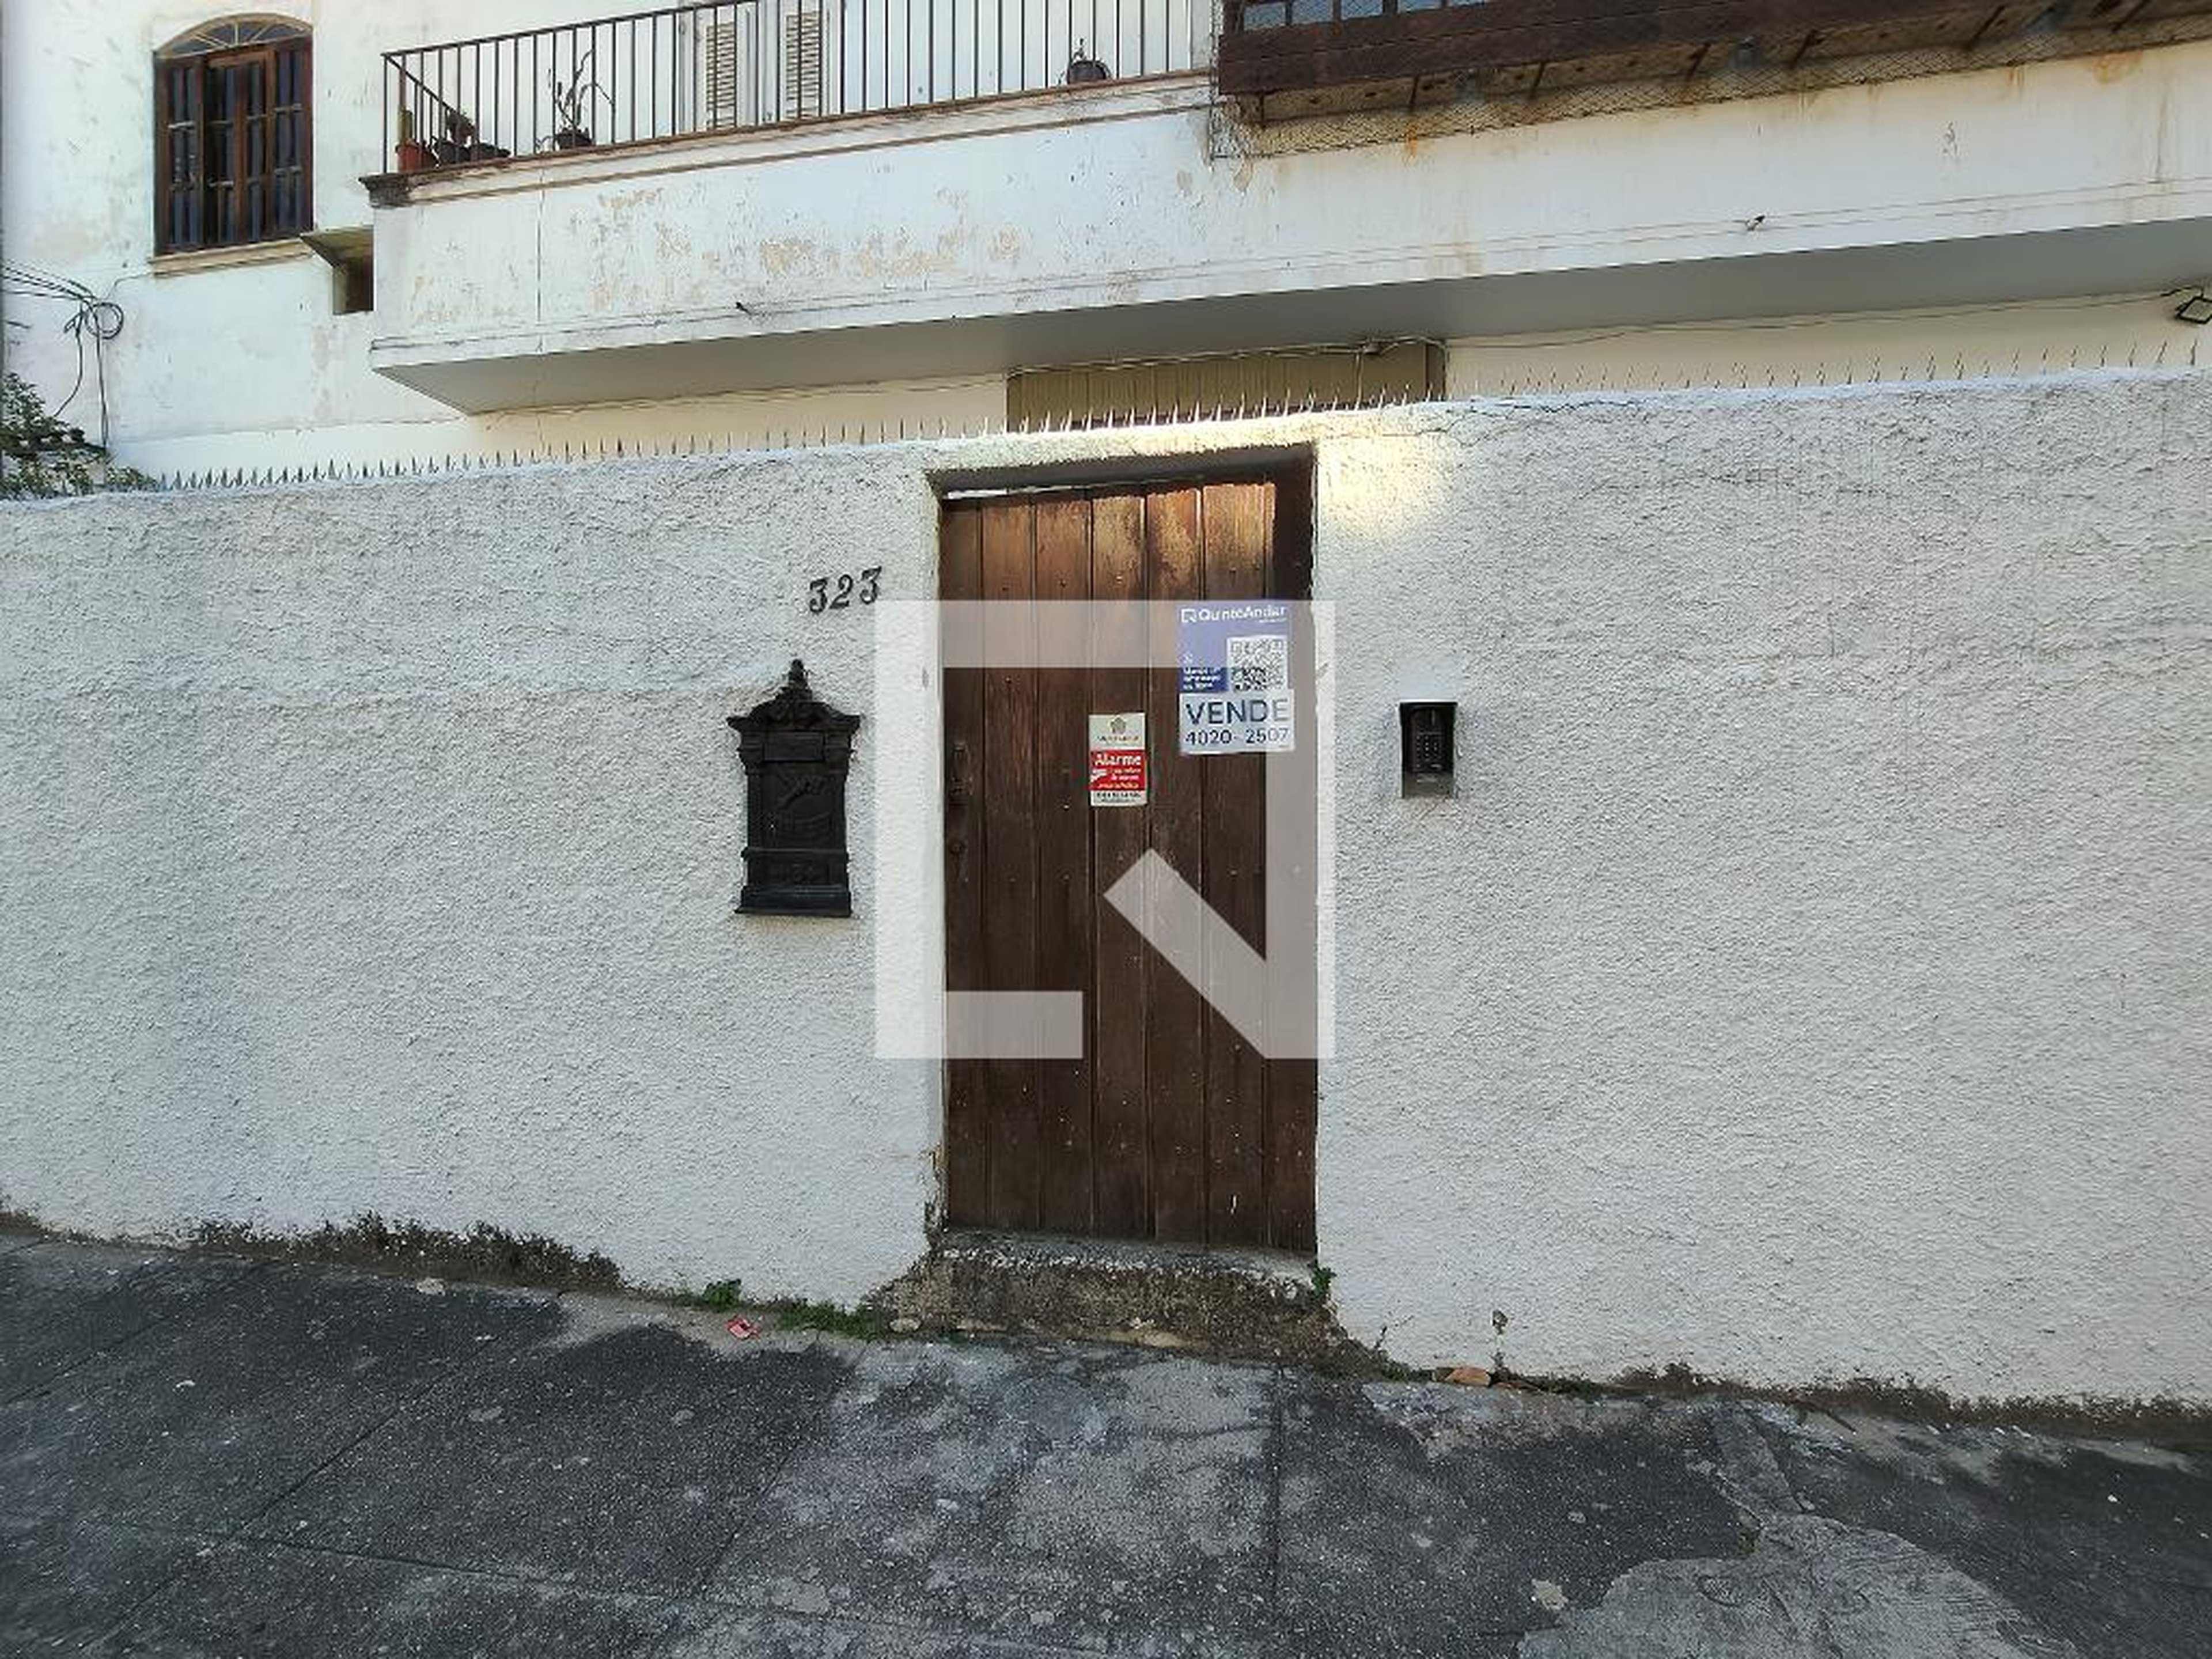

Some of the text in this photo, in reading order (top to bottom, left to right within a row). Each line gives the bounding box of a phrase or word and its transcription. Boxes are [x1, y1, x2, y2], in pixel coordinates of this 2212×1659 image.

[809, 566, 882, 613] 323
[1185, 699, 1288, 724] VENDE
[1095, 753, 1142, 766] Alarme
